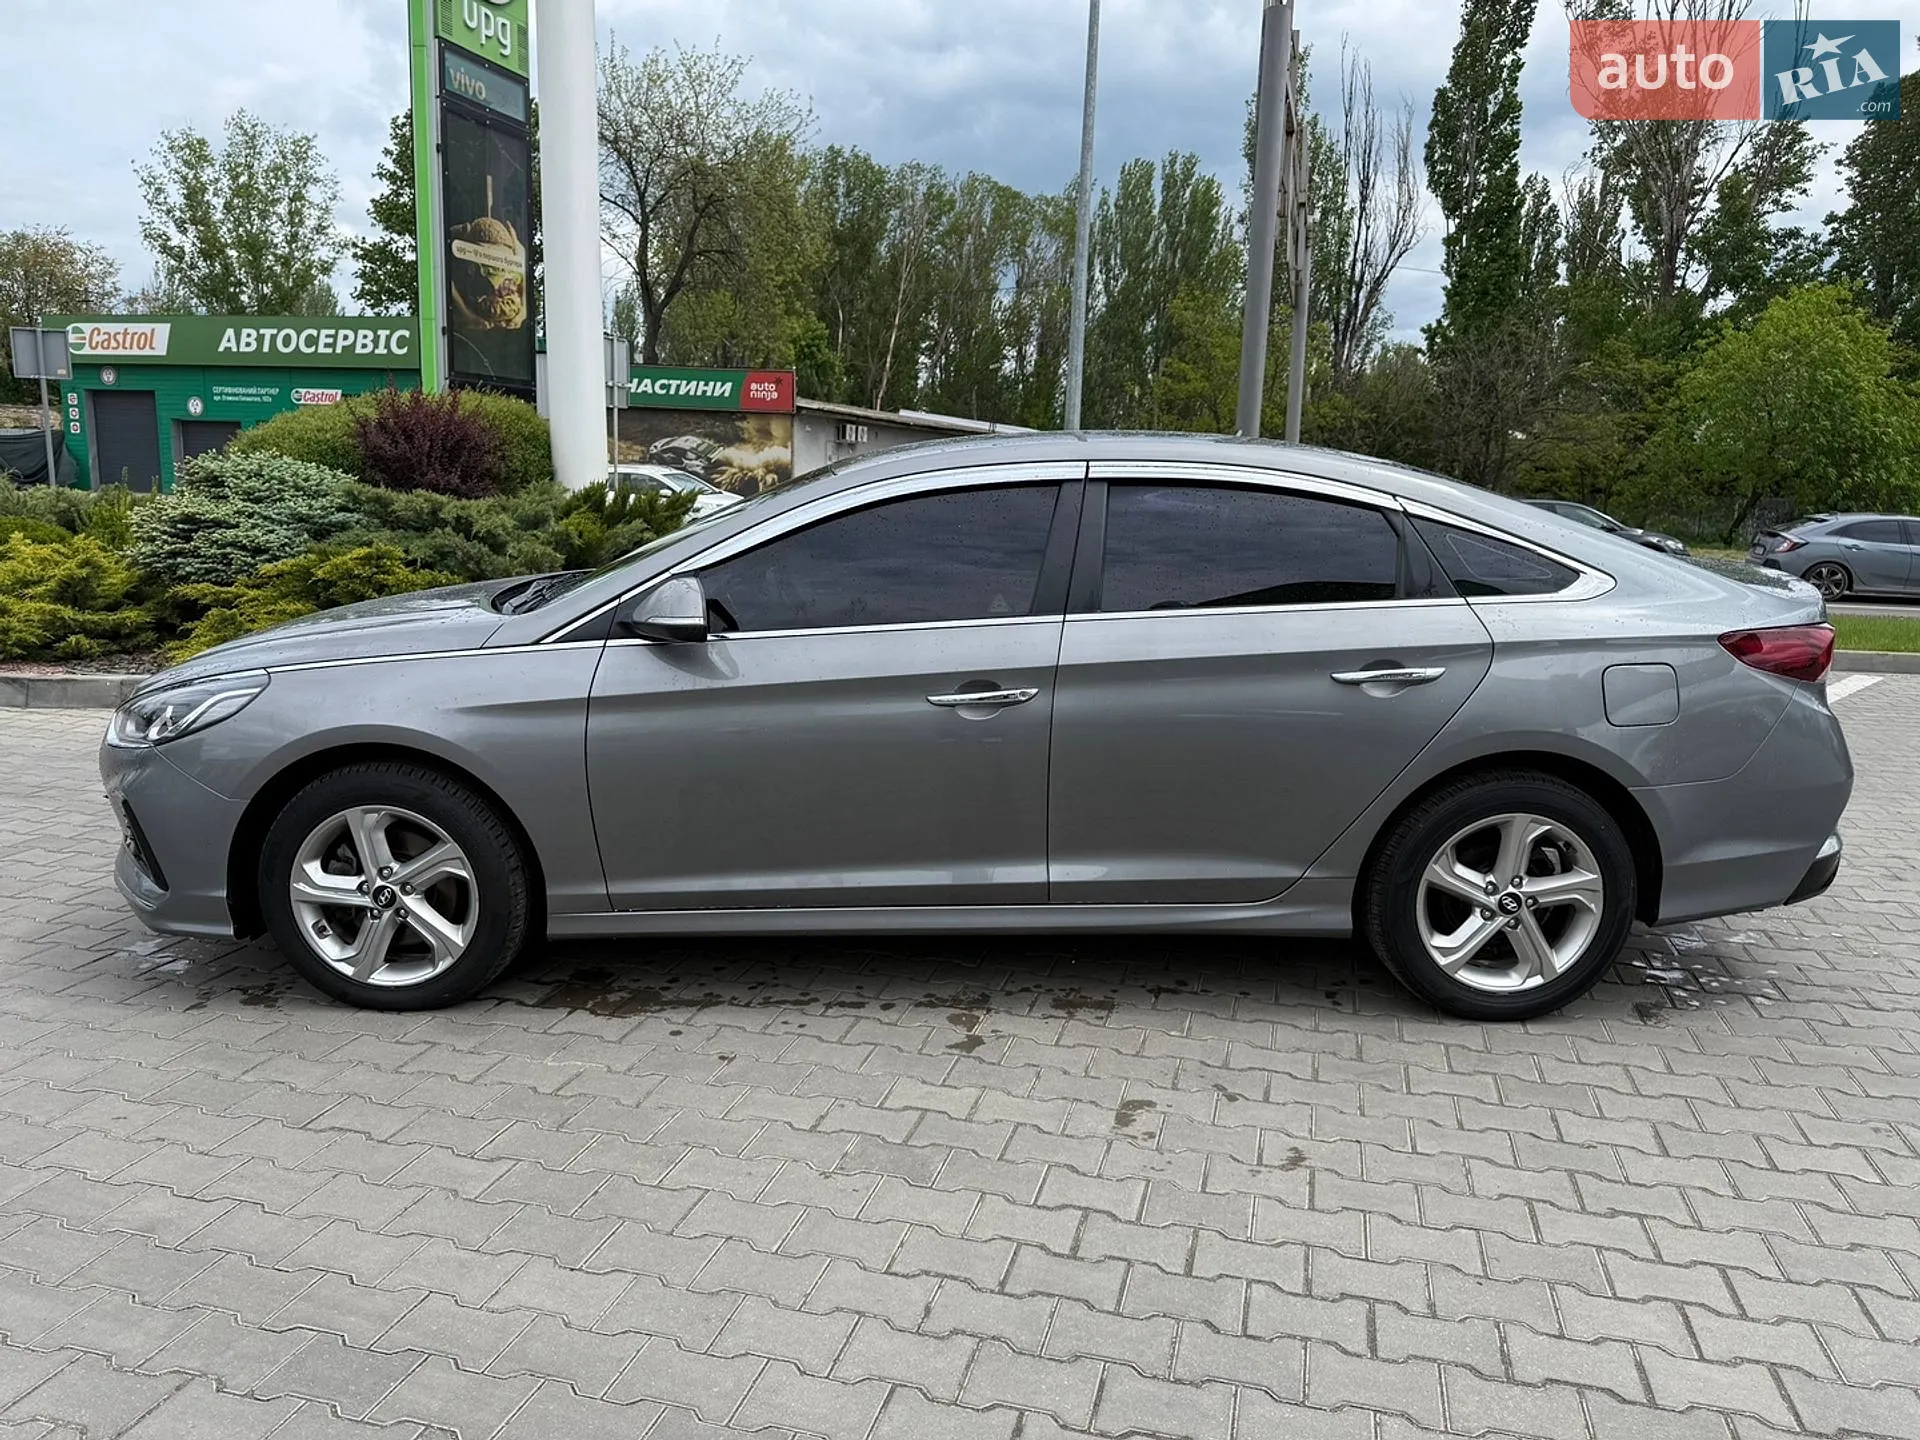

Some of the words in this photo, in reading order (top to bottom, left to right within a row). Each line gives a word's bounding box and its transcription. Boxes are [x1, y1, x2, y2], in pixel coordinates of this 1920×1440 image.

[464, 0, 511, 56] upg
[449, 67, 486, 100] vivo
[88, 326, 156, 351] Castrol
[217, 328, 411, 355] АВТОСЕРВІС
[303, 391, 339, 403] Castrol
[750, 382, 776, 391] auto
[750, 390, 778, 401] ninja
